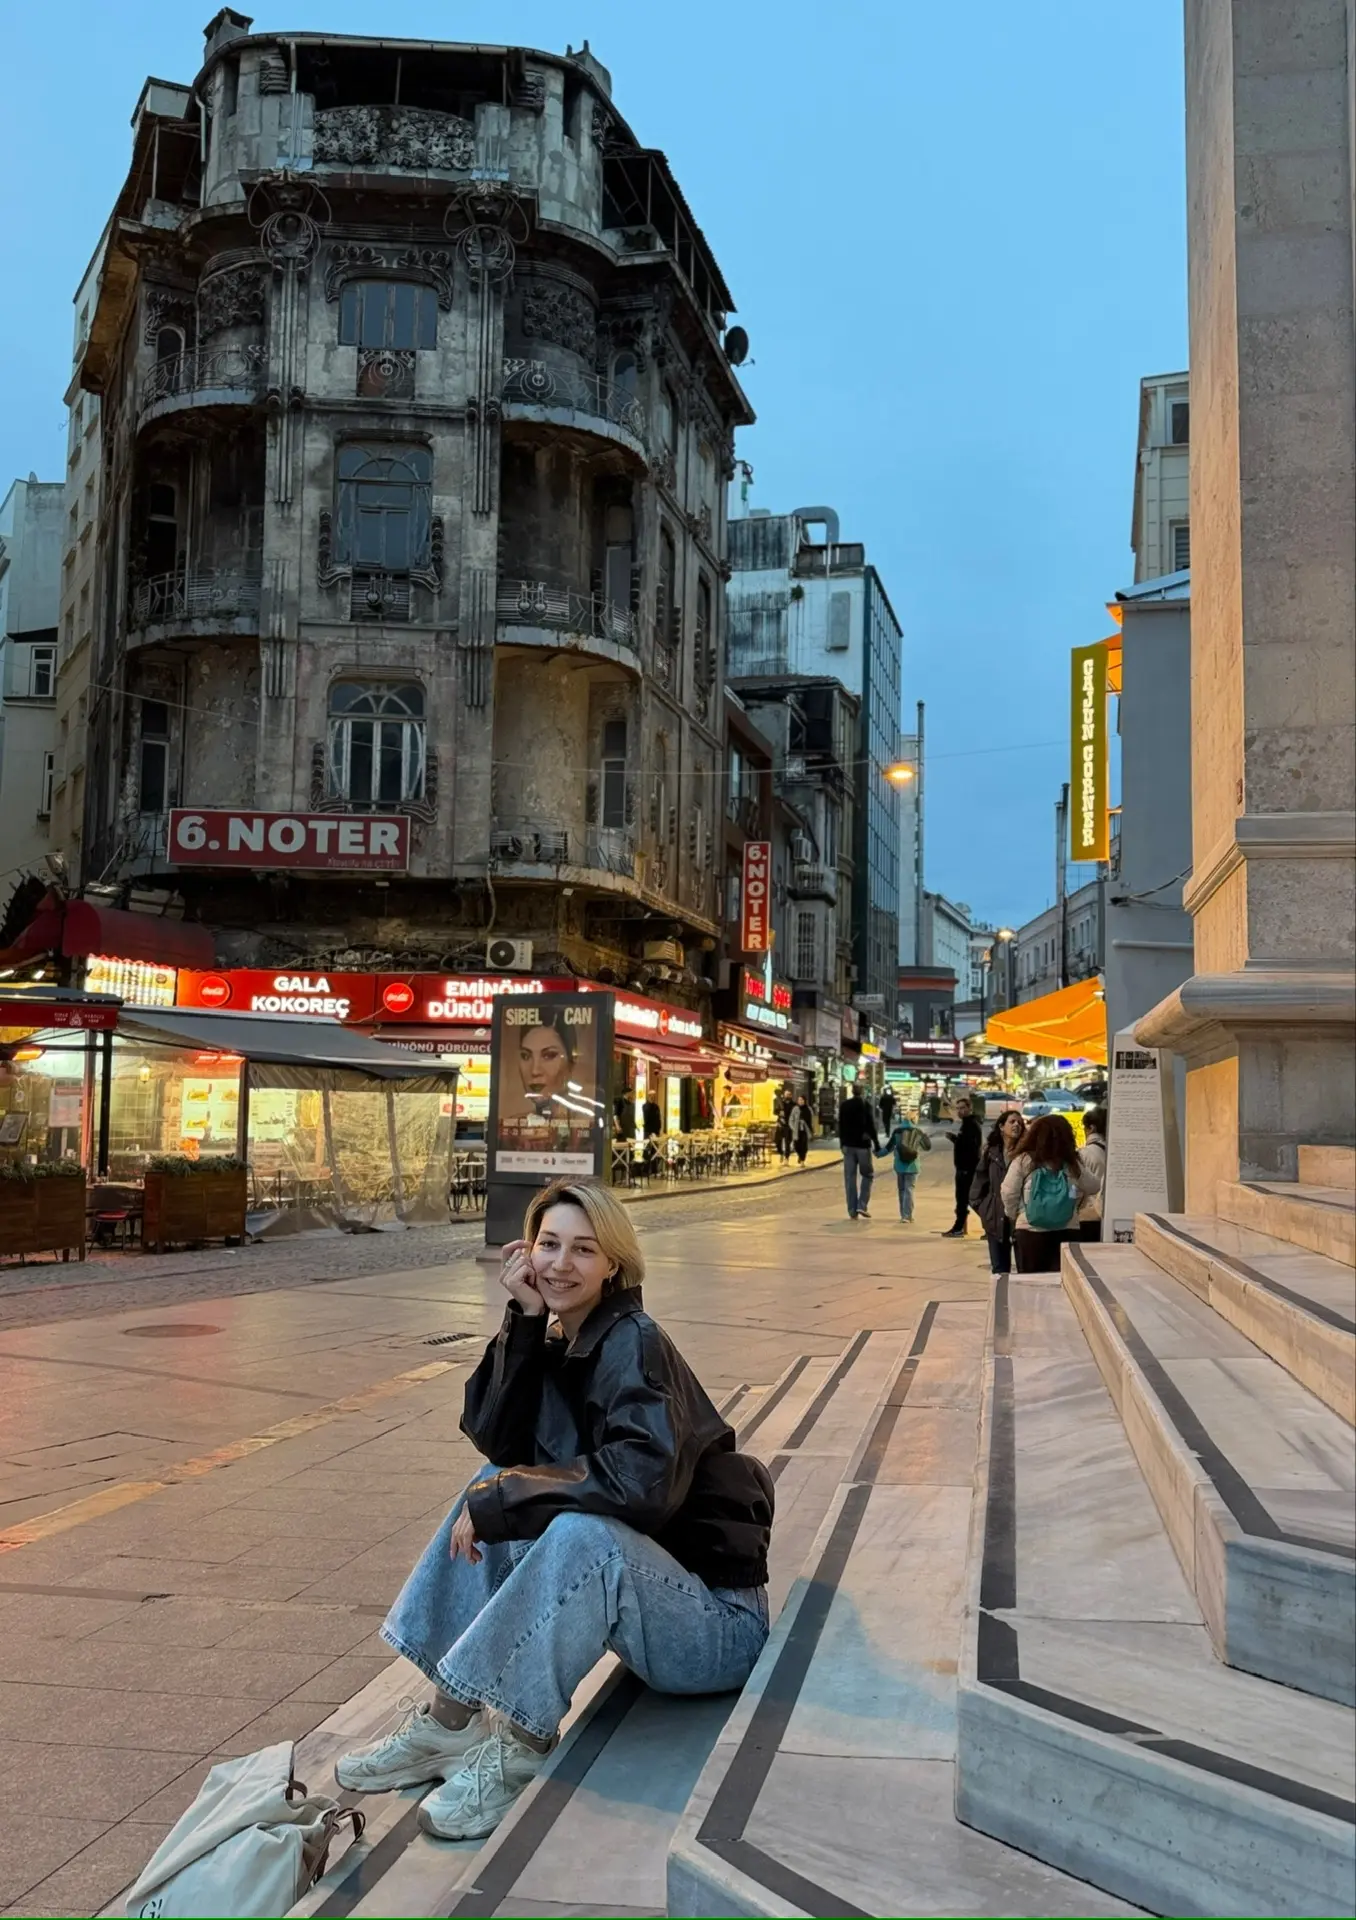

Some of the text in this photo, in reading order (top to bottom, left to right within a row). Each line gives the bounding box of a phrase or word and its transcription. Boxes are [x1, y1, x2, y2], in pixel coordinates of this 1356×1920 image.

[1082, 659, 1095, 847] CAJUN CORNER
[176, 815, 400, 855] 6. NOTER
[747, 845, 767, 949] 6. NOTER
[273, 976, 330, 993] GALA
[251, 996, 350, 1019] KOKOREÇ
[564, 1007, 592, 1024] CAN
